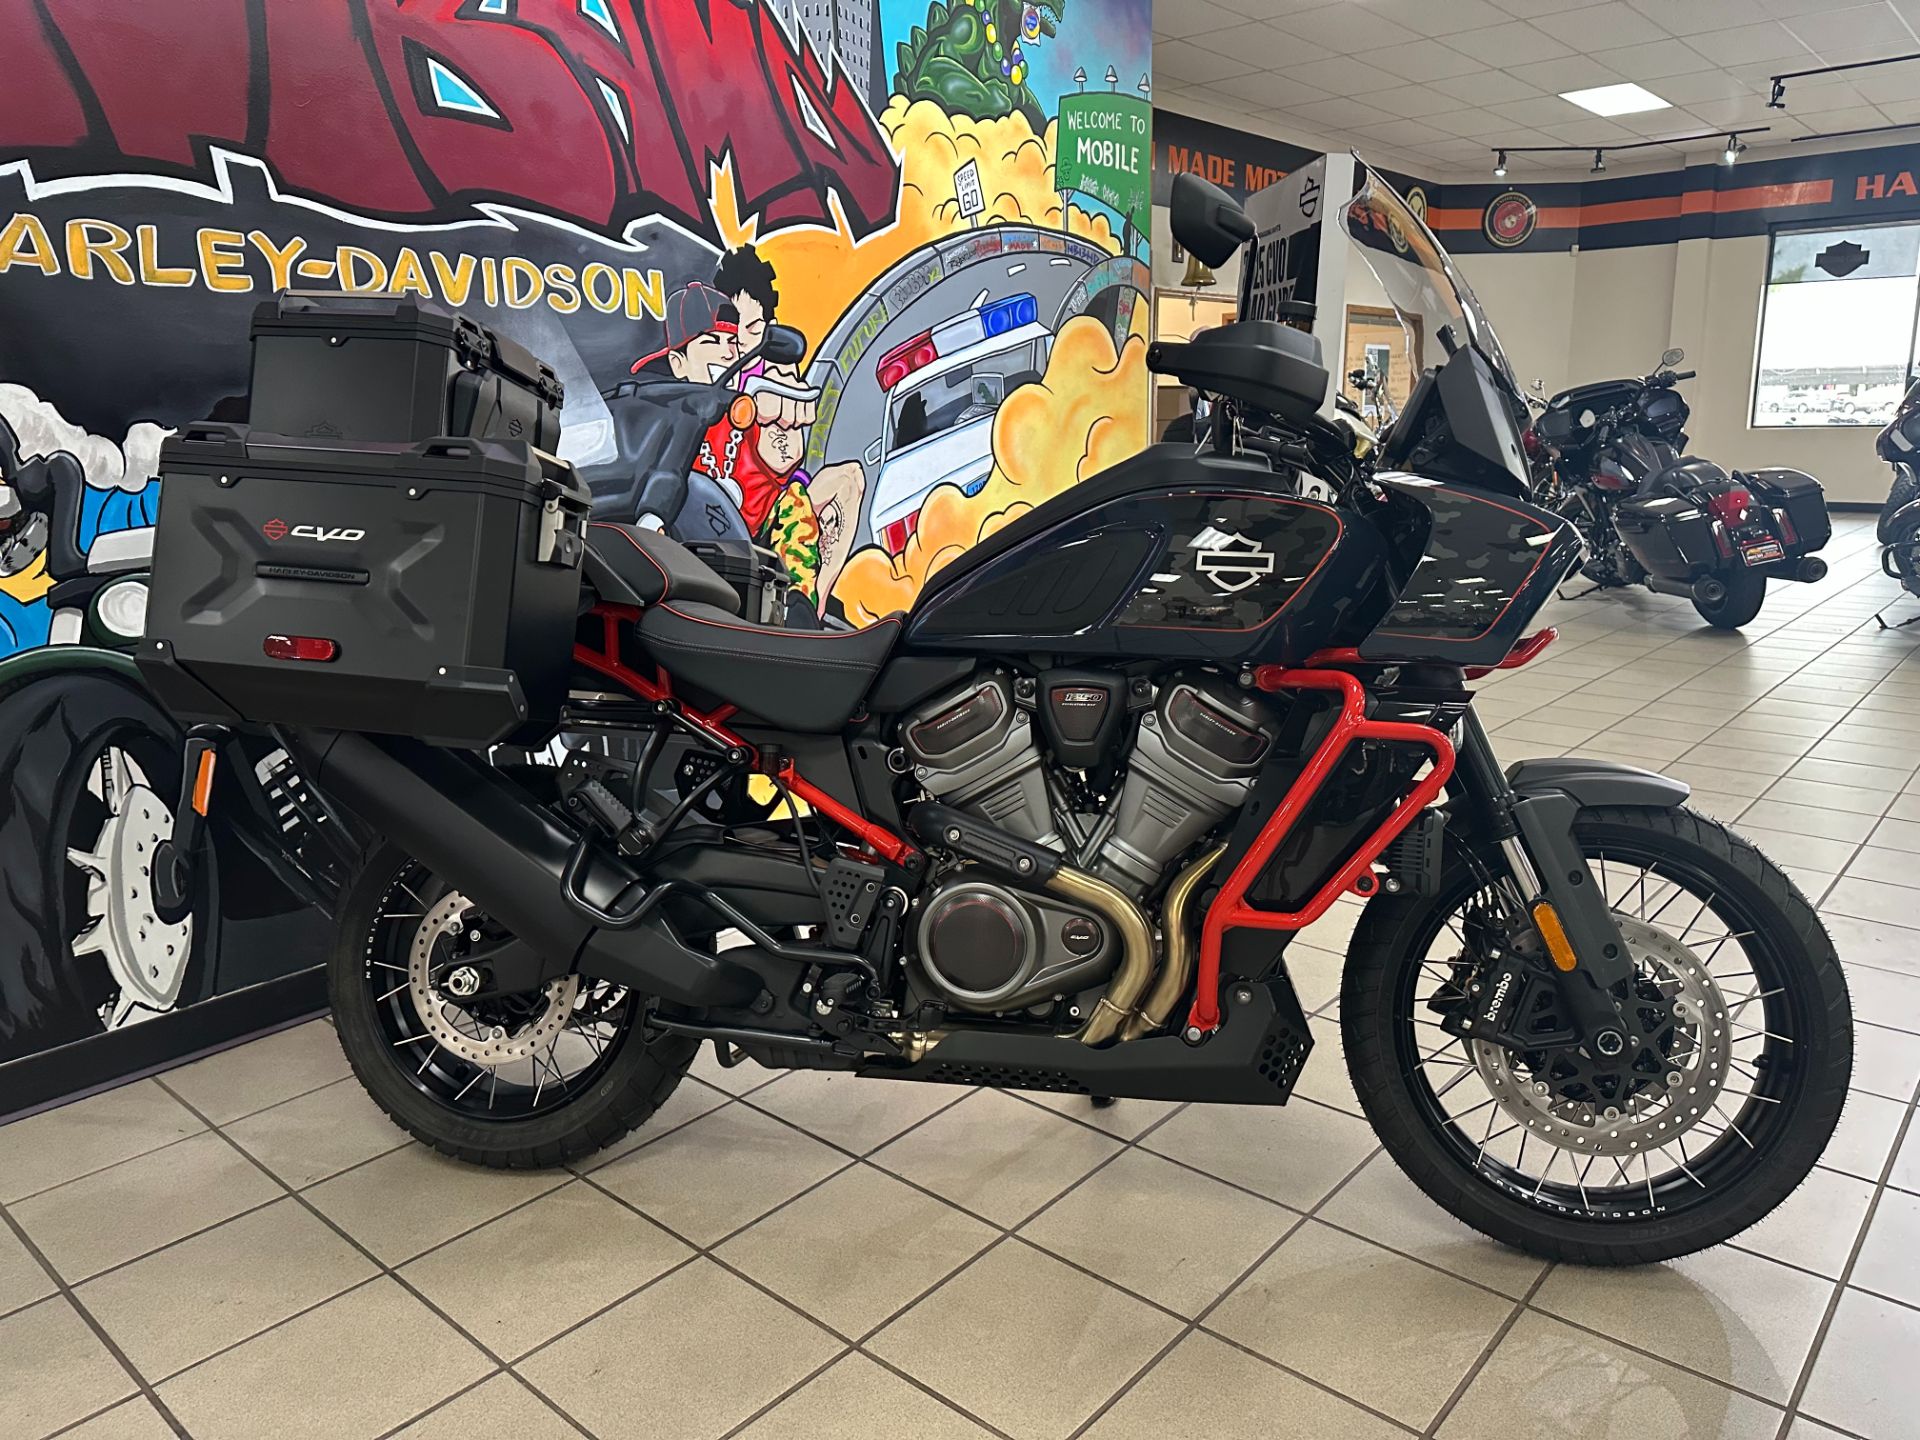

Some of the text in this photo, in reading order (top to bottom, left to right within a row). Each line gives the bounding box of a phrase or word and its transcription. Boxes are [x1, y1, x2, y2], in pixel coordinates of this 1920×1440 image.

[1067, 110, 1146, 135] WELCOME TO
[1077, 137, 1139, 175] MOBILE
[1168, 144, 1235, 188] MADE
[957, 169, 975, 185] SPEED
[1855, 171, 1918, 200] HA
[1242, 237, 1287, 291] 225 CVO
[809, 379, 841, 460] PAST
[290, 525, 366, 542] CVO
[268, 566, 356, 580] HARLEY-DAVIDSON
[1065, 692, 1103, 702] 1250
[365, 859, 417, 979] LEY-DAVIDSON
[1483, 972, 1512, 1022] brembo
